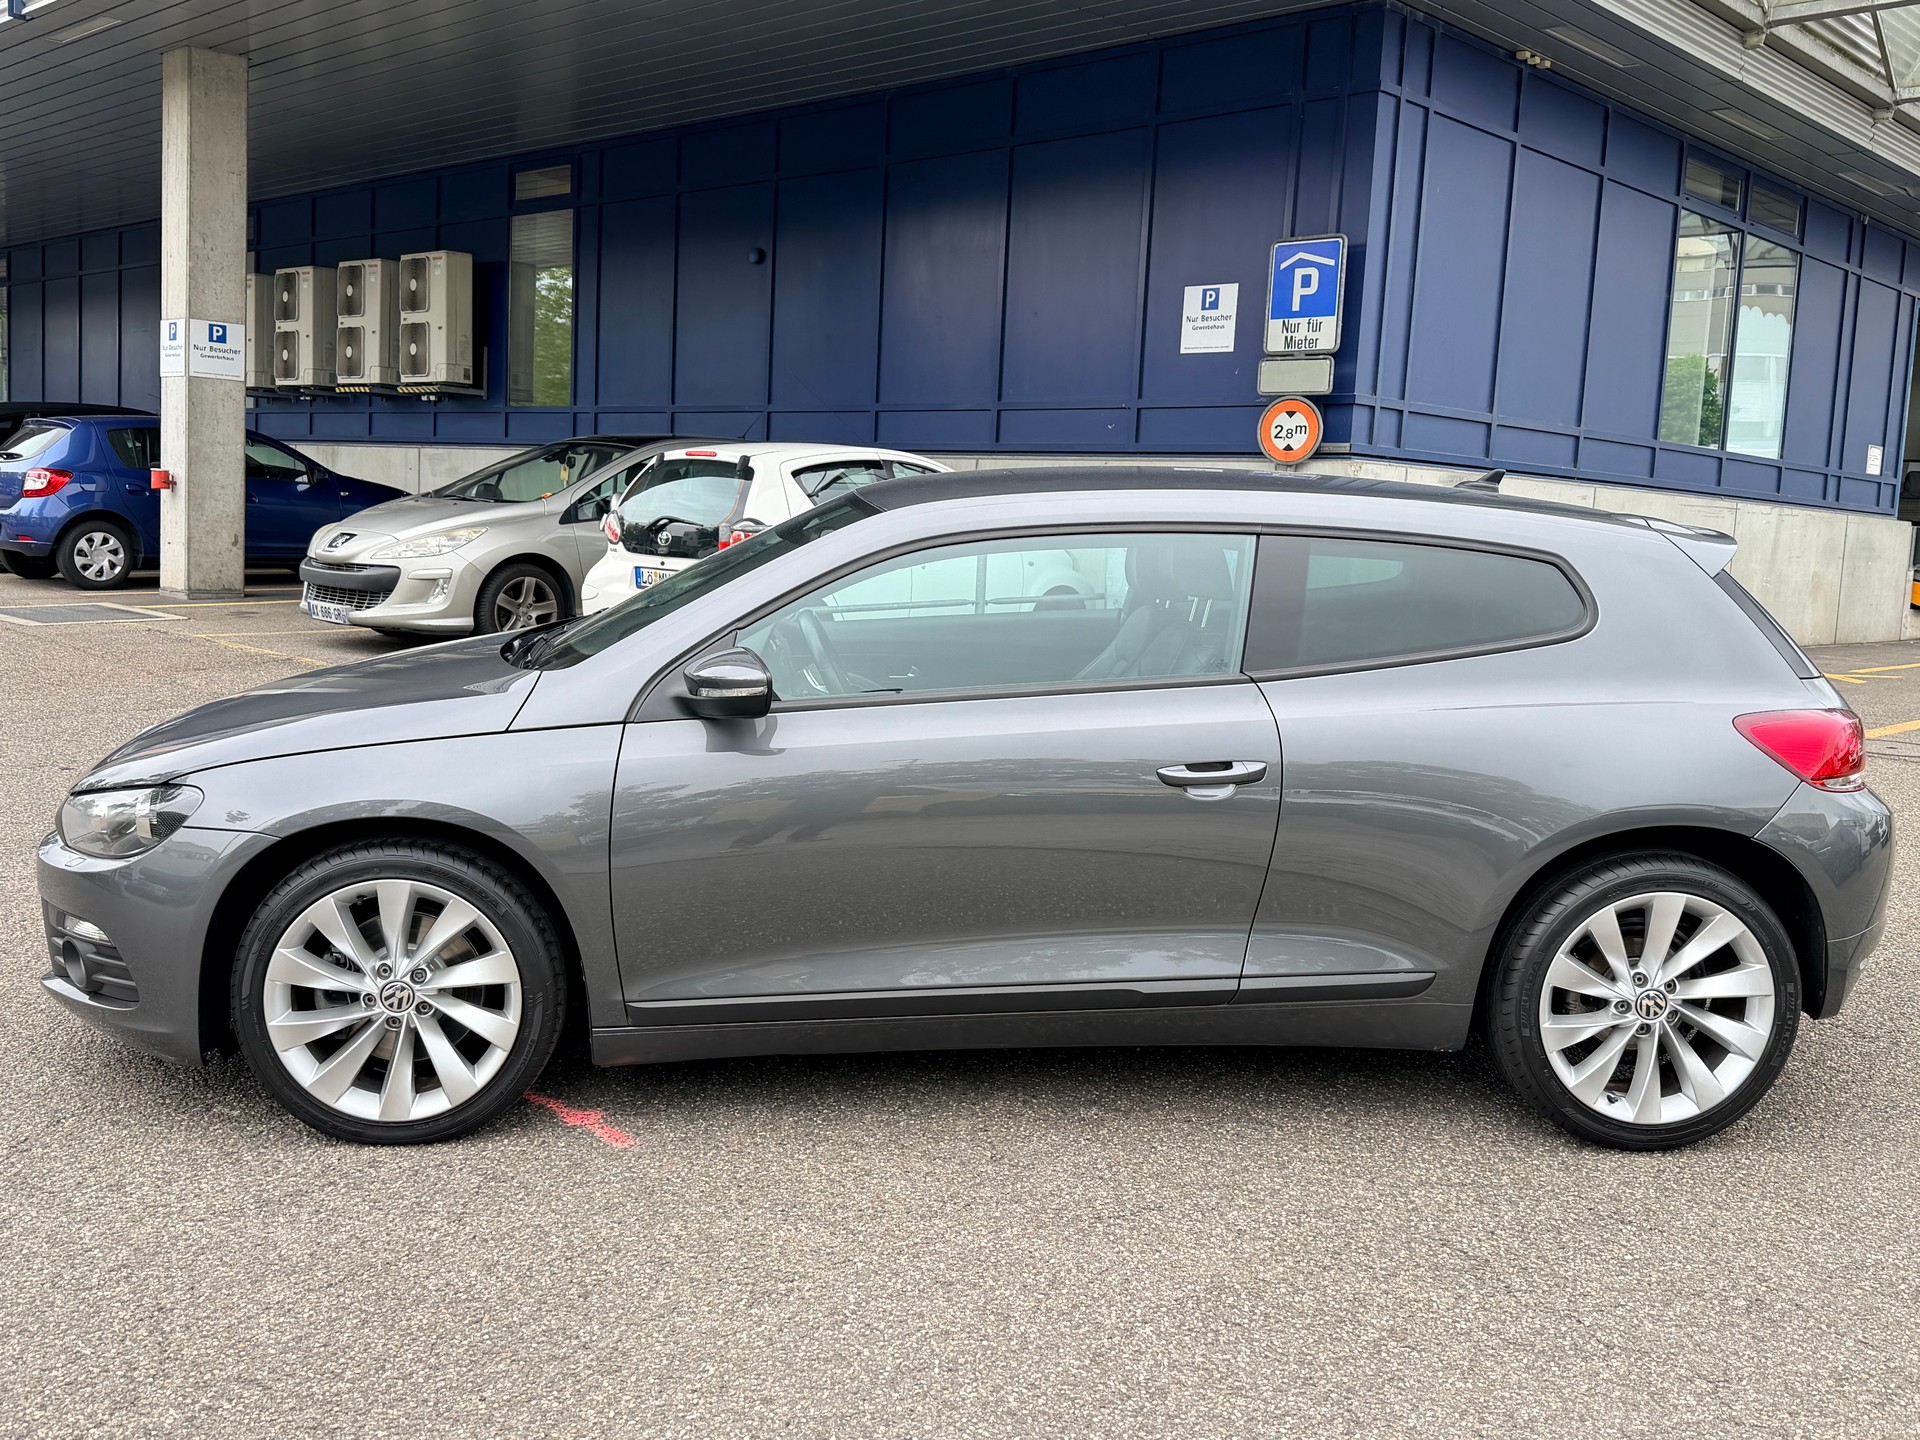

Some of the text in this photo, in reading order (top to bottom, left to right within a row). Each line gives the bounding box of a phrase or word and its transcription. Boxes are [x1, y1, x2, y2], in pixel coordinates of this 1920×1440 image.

[1292, 267, 1319, 311] P
[1205, 290, 1216, 308] P
[1186, 313, 1232, 323] Nur Besucher
[212, 325, 223, 341] P
[1281, 318, 1323, 334] Nur für
[193, 343, 241, 355] Nur Besucher
[1283, 335, 1319, 350] Mieter
[200, 353, 235, 362] Gewerbehaus
